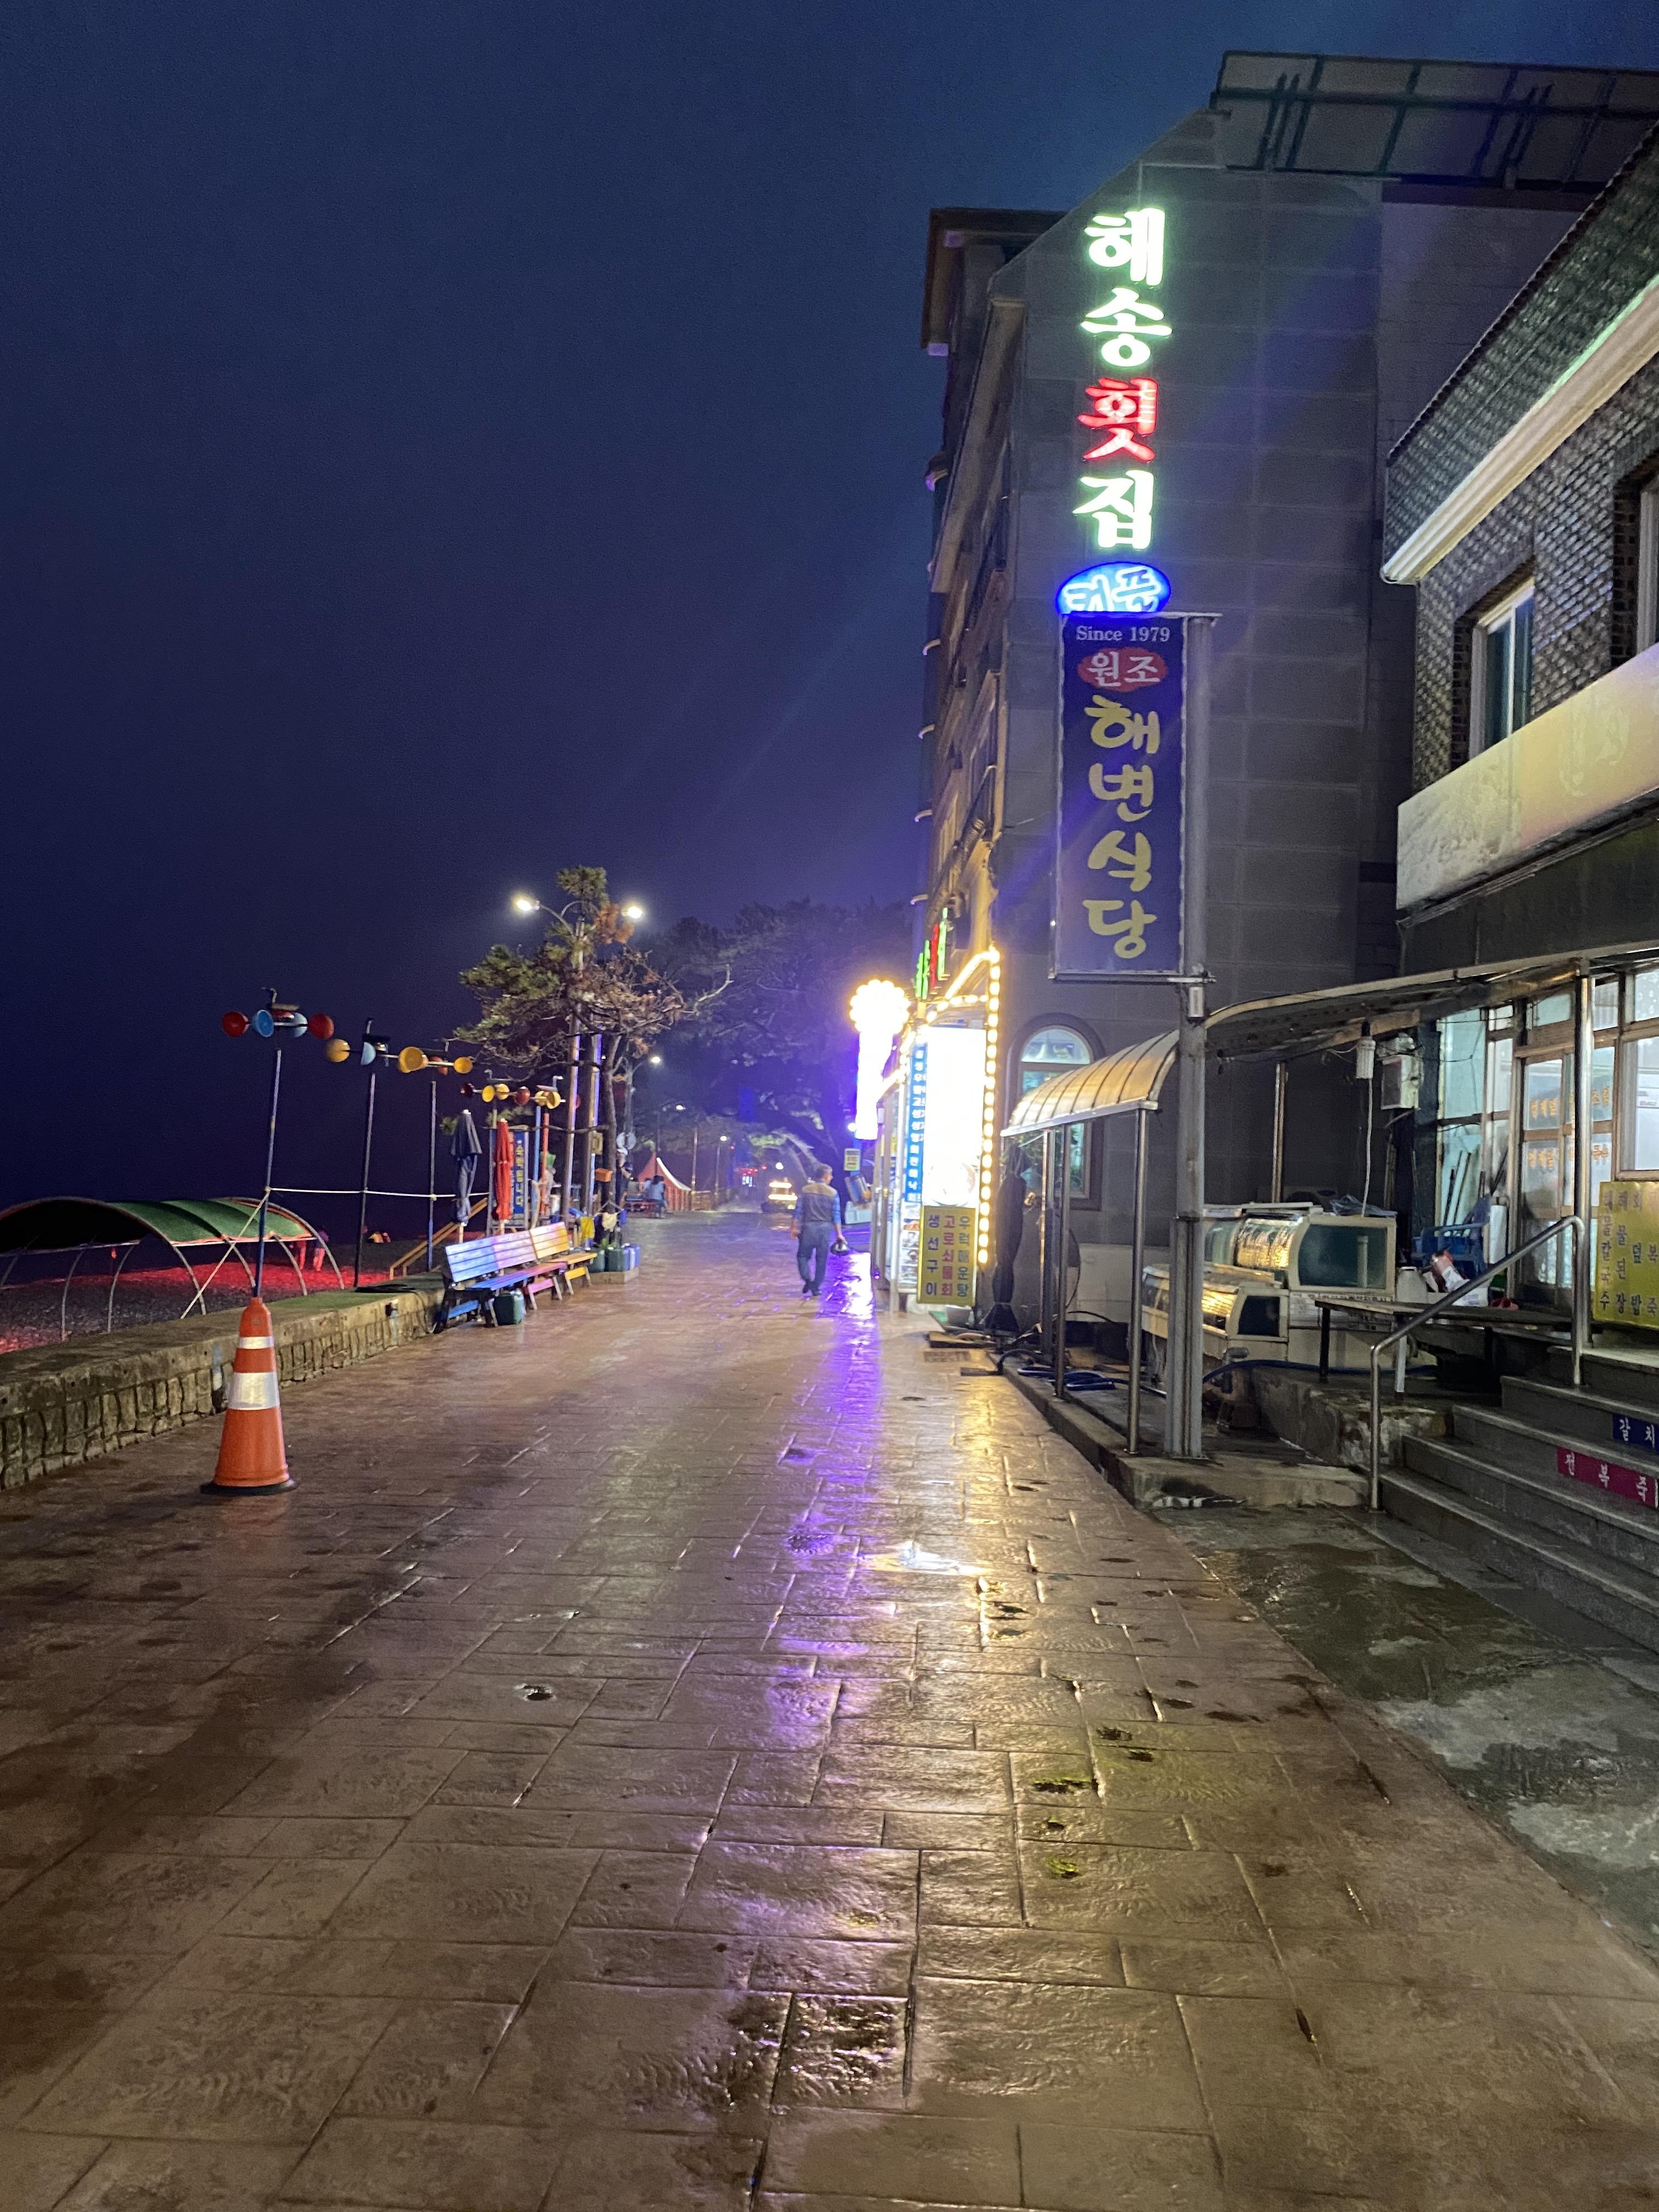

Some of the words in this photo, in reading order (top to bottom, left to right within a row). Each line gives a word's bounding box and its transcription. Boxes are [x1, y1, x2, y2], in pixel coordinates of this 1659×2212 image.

[1076, 625, 1123, 641] Since
[1130, 627, 1171, 642] 1979
[1086, 651, 1161, 687] 원조
[1082, 694, 1161, 959] 해변식당
[926, 1214, 940, 1296] 생선구이
[1565, 1452, 1648, 1502] 전복죽
